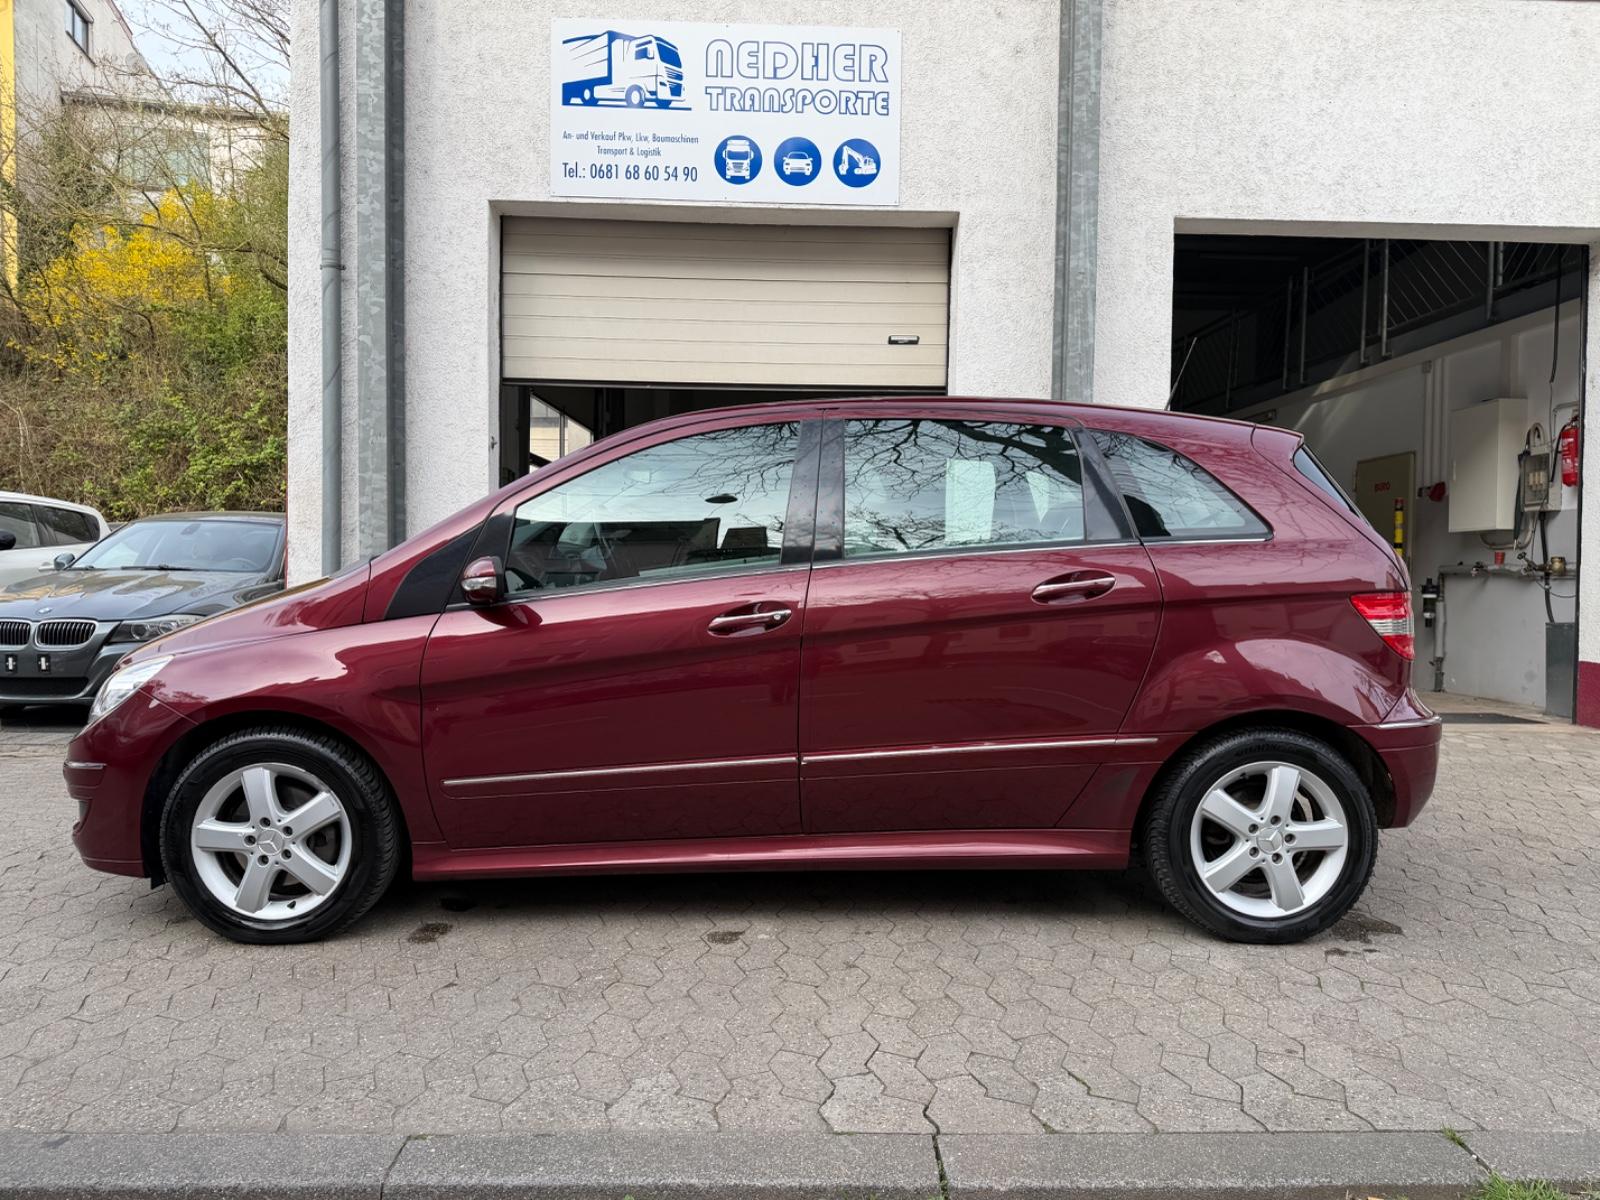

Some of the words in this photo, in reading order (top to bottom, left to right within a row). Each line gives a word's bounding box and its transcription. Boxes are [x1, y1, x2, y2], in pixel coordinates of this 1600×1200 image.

[705, 38, 889, 83] NEDHER
[704, 86, 890, 116] TRANSPORTE
[562, 130, 574, 140] An-
[576, 131, 589, 140] und
[590, 131, 616, 141] Verkauf
[618, 132, 634, 143] Pkw,
[635, 133, 650, 143] Lkw,
[652, 133, 699, 144] Baumaschinen
[597, 145, 627, 157] Transport
[629, 147, 635, 156] &
[637, 147, 662, 158] Logistik
[562, 161, 586, 179] Tel.:
[590, 163, 619, 179] 0681
[625, 164, 640, 180] 68
[644, 165, 660, 181] 60
[664, 165, 679, 181] 54
[683, 166, 698, 182] 90
